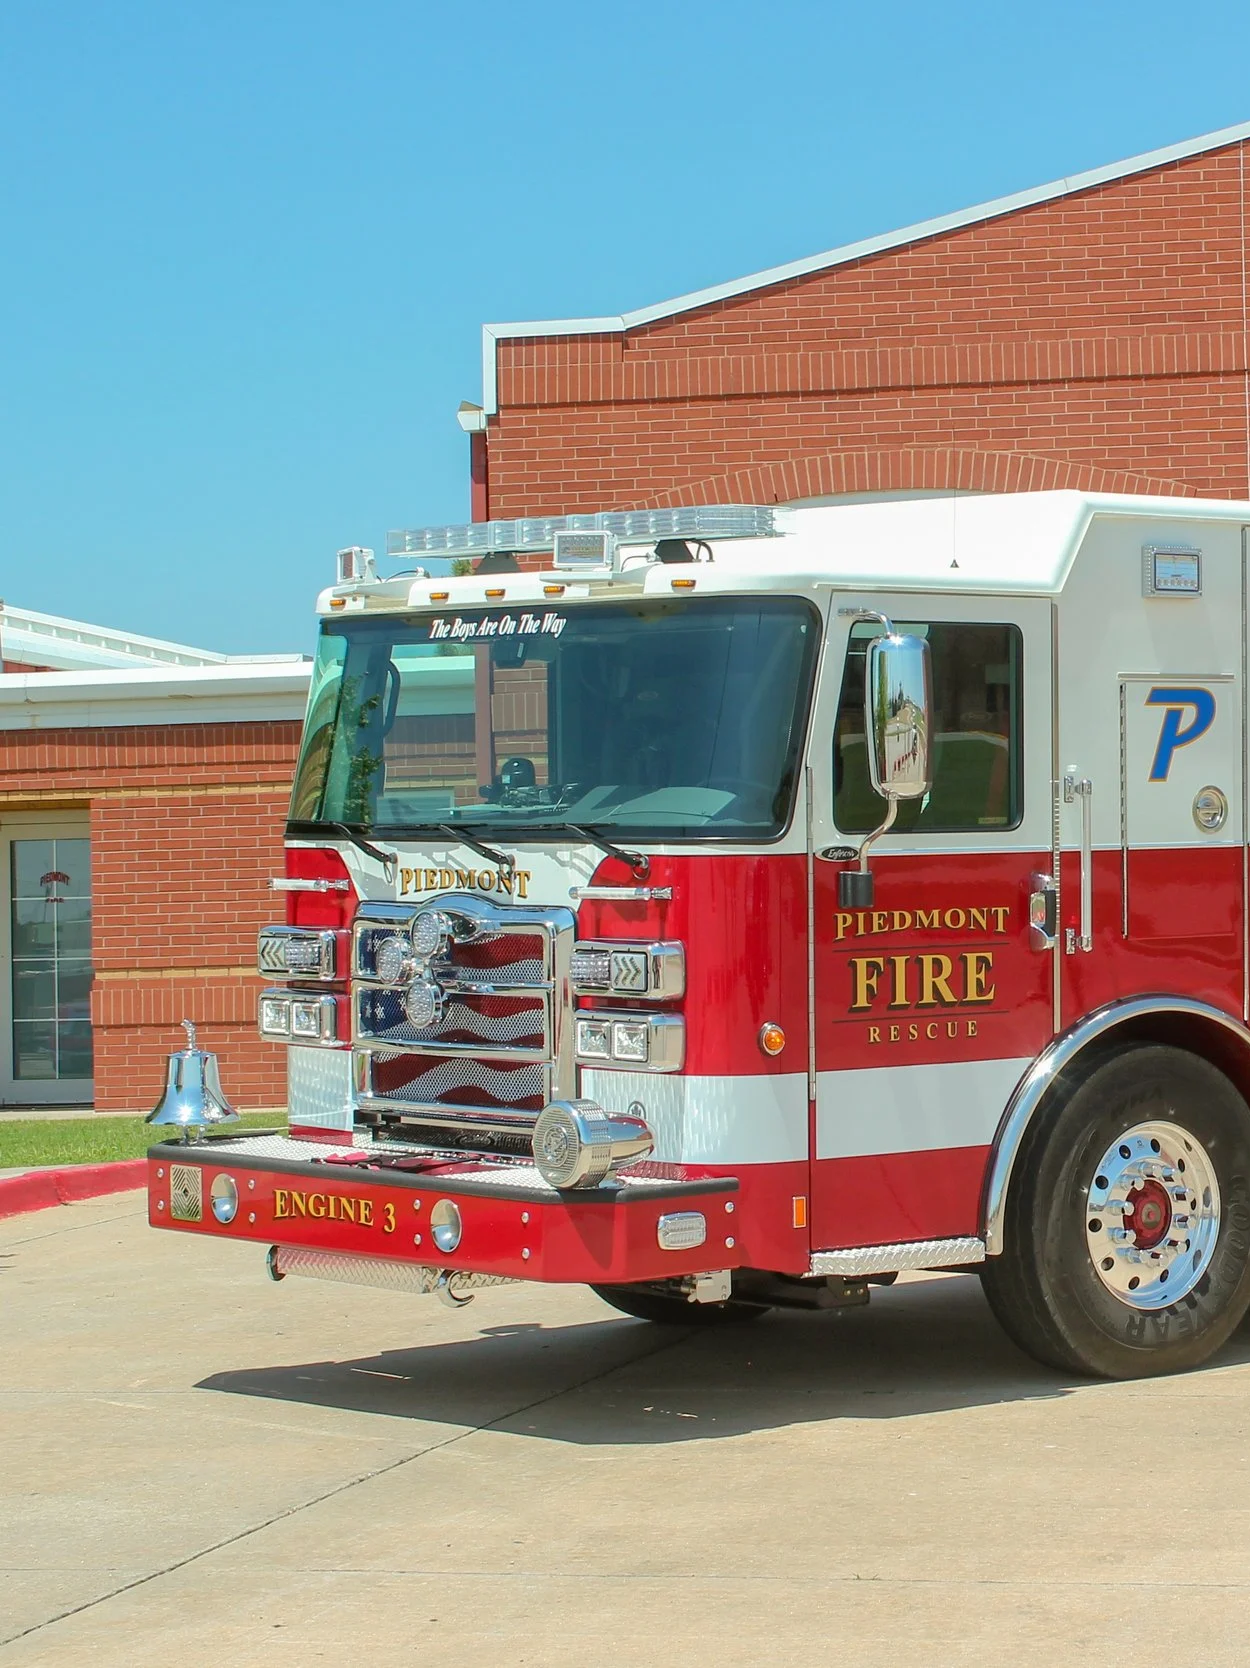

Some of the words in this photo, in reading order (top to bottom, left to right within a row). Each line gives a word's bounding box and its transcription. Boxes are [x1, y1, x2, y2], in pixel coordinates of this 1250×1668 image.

[429, 618, 450, 639] The
[450, 617, 477, 642] Boys
[476, 616, 496, 637] Are
[499, 614, 516, 636] On
[517, 613, 541, 635] The
[541, 612, 567, 638] Way
[1144, 686, 1217, 783] P
[400, 868, 532, 899] PIEDMONT
[833, 907, 1010, 942] PIEDMONT
[848, 952, 996, 1013] FIRE
[867, 1020, 978, 1044] RESCUE
[273, 1189, 375, 1227] ENGINE
[383, 1202, 397, 1234] 3
